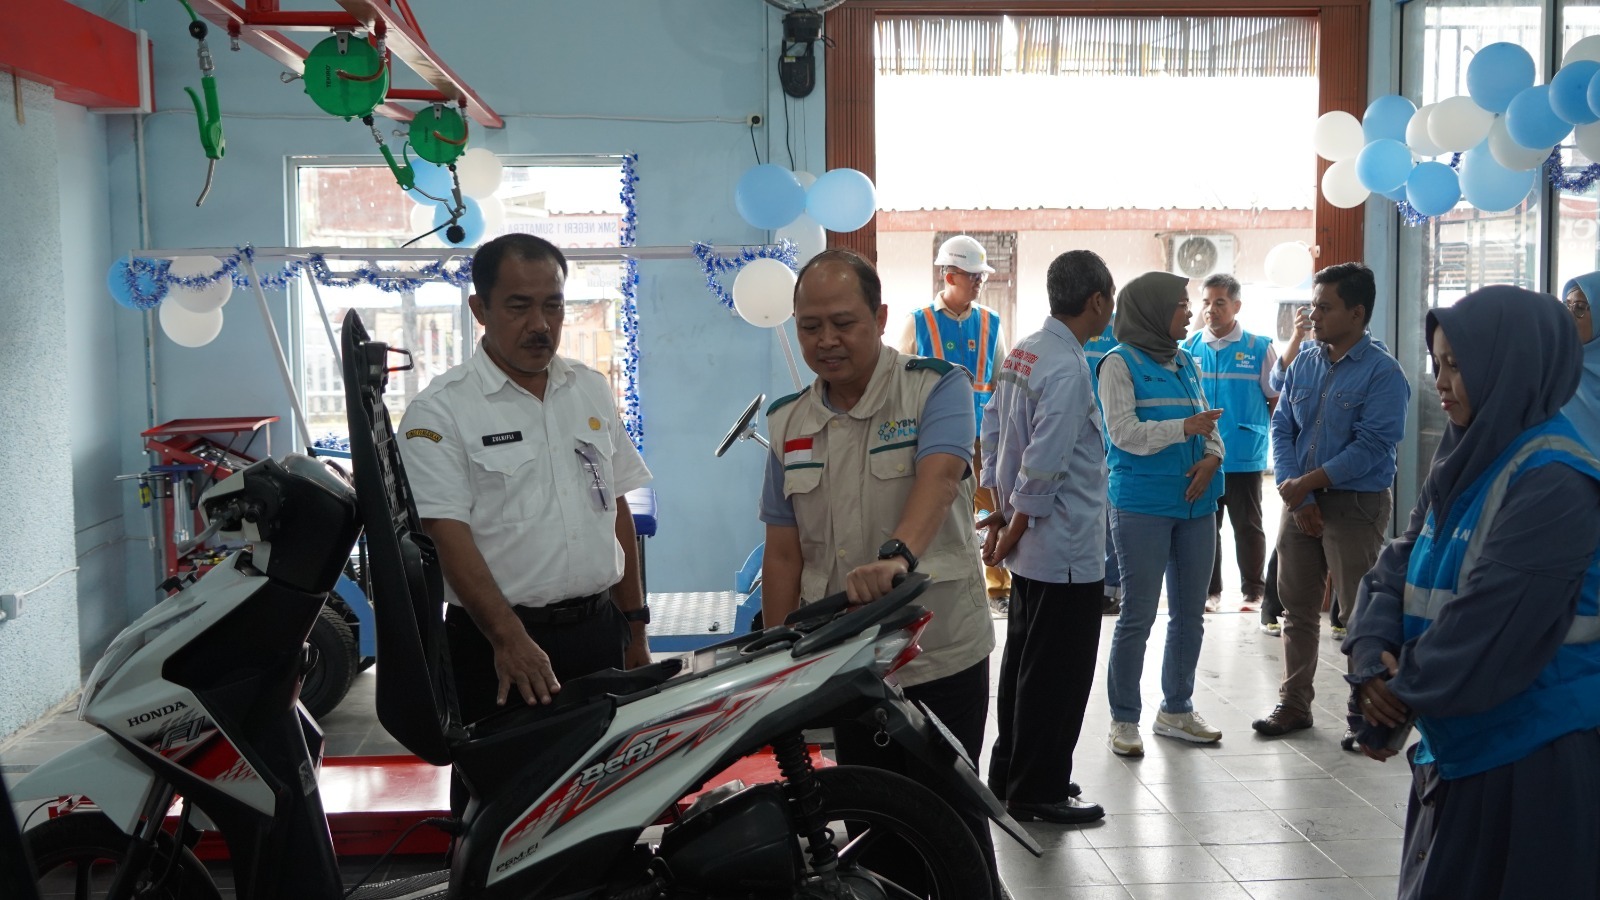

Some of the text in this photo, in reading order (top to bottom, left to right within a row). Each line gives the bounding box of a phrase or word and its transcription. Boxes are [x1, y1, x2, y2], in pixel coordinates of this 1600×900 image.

[896, 418, 917, 428] YBM
[897, 427, 917, 437] PLN
[126, 700, 189, 728] HONDA
[159, 715, 207, 752] FI
